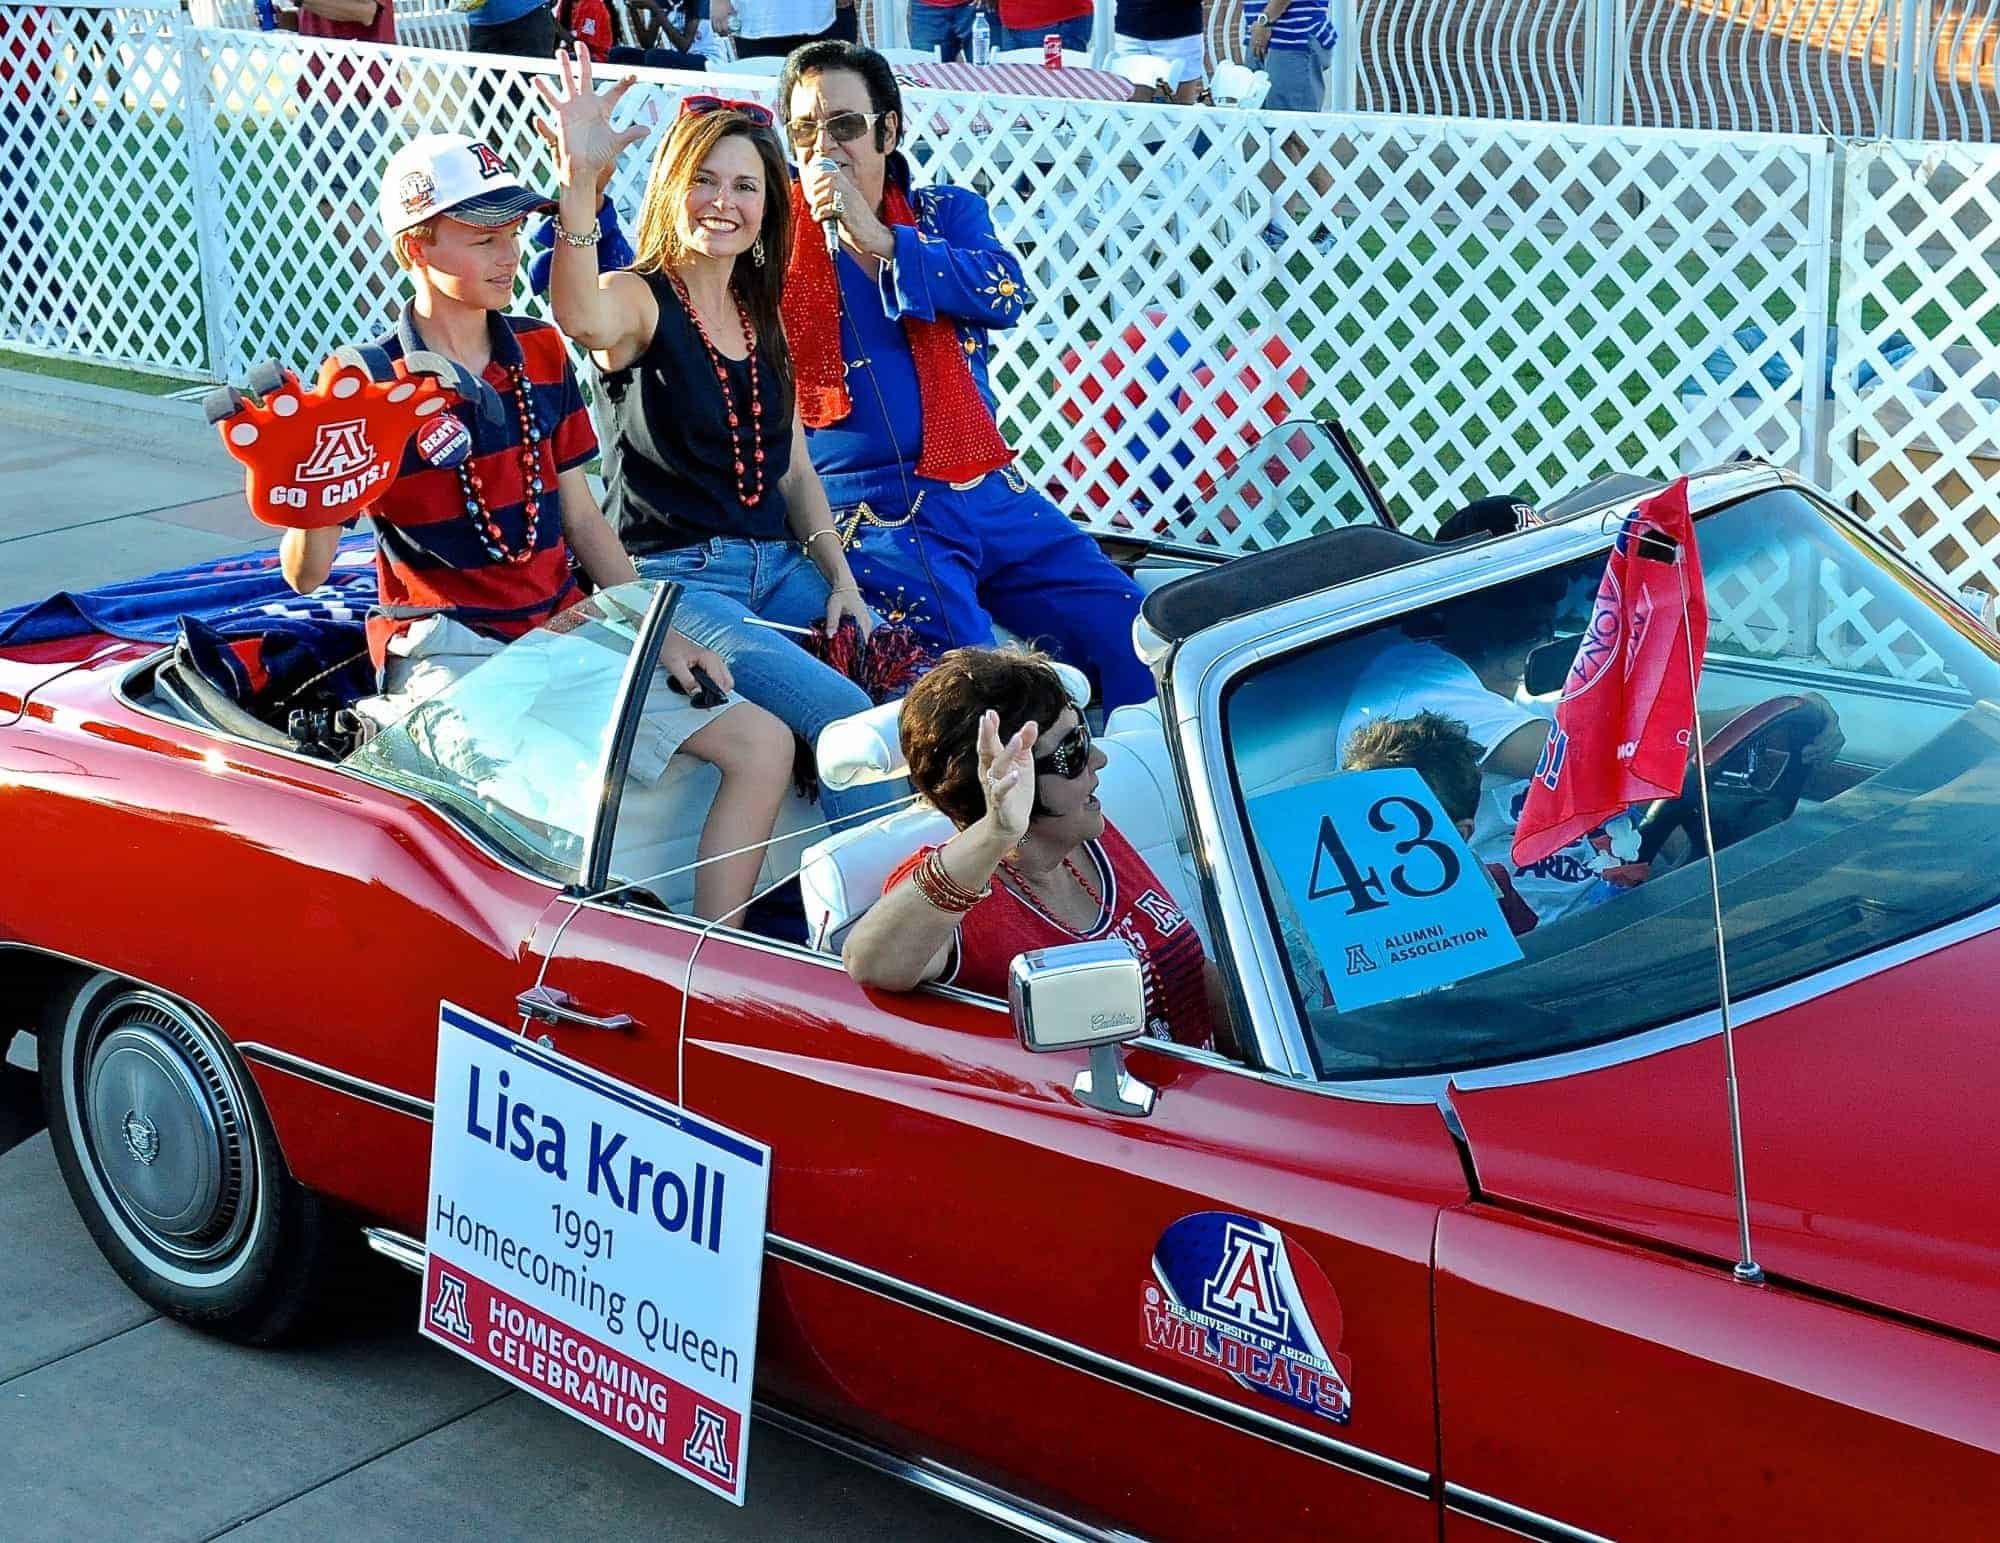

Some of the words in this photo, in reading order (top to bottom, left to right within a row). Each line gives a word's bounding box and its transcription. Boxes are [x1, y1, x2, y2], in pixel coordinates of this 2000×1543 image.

[467, 143, 510, 179] A
[296, 418, 375, 482] A
[420, 420, 455, 453] BEAT
[269, 485, 308, 508] GO
[322, 461, 391, 507] CATS!
[1308, 796, 1461, 915] 43
[1134, 889, 1187, 937] A
[1385, 924, 1444, 949] ALUMNI
[1390, 927, 1488, 964] ASSOCIATION
[1344, 943, 1377, 975] A
[467, 1064, 568, 1181] Lisa
[587, 1121, 725, 1254] Kroll
[552, 1204, 613, 1259] 1991
[431, 1270, 472, 1343] A
[436, 1195, 626, 1335] Homecoming
[637, 1299, 739, 1384] Queen
[1203, 1222, 1289, 1340] A
[489, 1297, 667, 1413] HOMECOMING
[1143, 1304, 1345, 1415] WILDCATS
[1164, 1300, 1187, 1318] THE
[1190, 1311, 1259, 1342] UNIVERSITY
[1260, 1337, 1276, 1350] OF
[1280, 1344, 1333, 1373] ARIZONA
[488, 1329, 666, 1445] CELEBRATION
[684, 1405, 732, 1481] A
